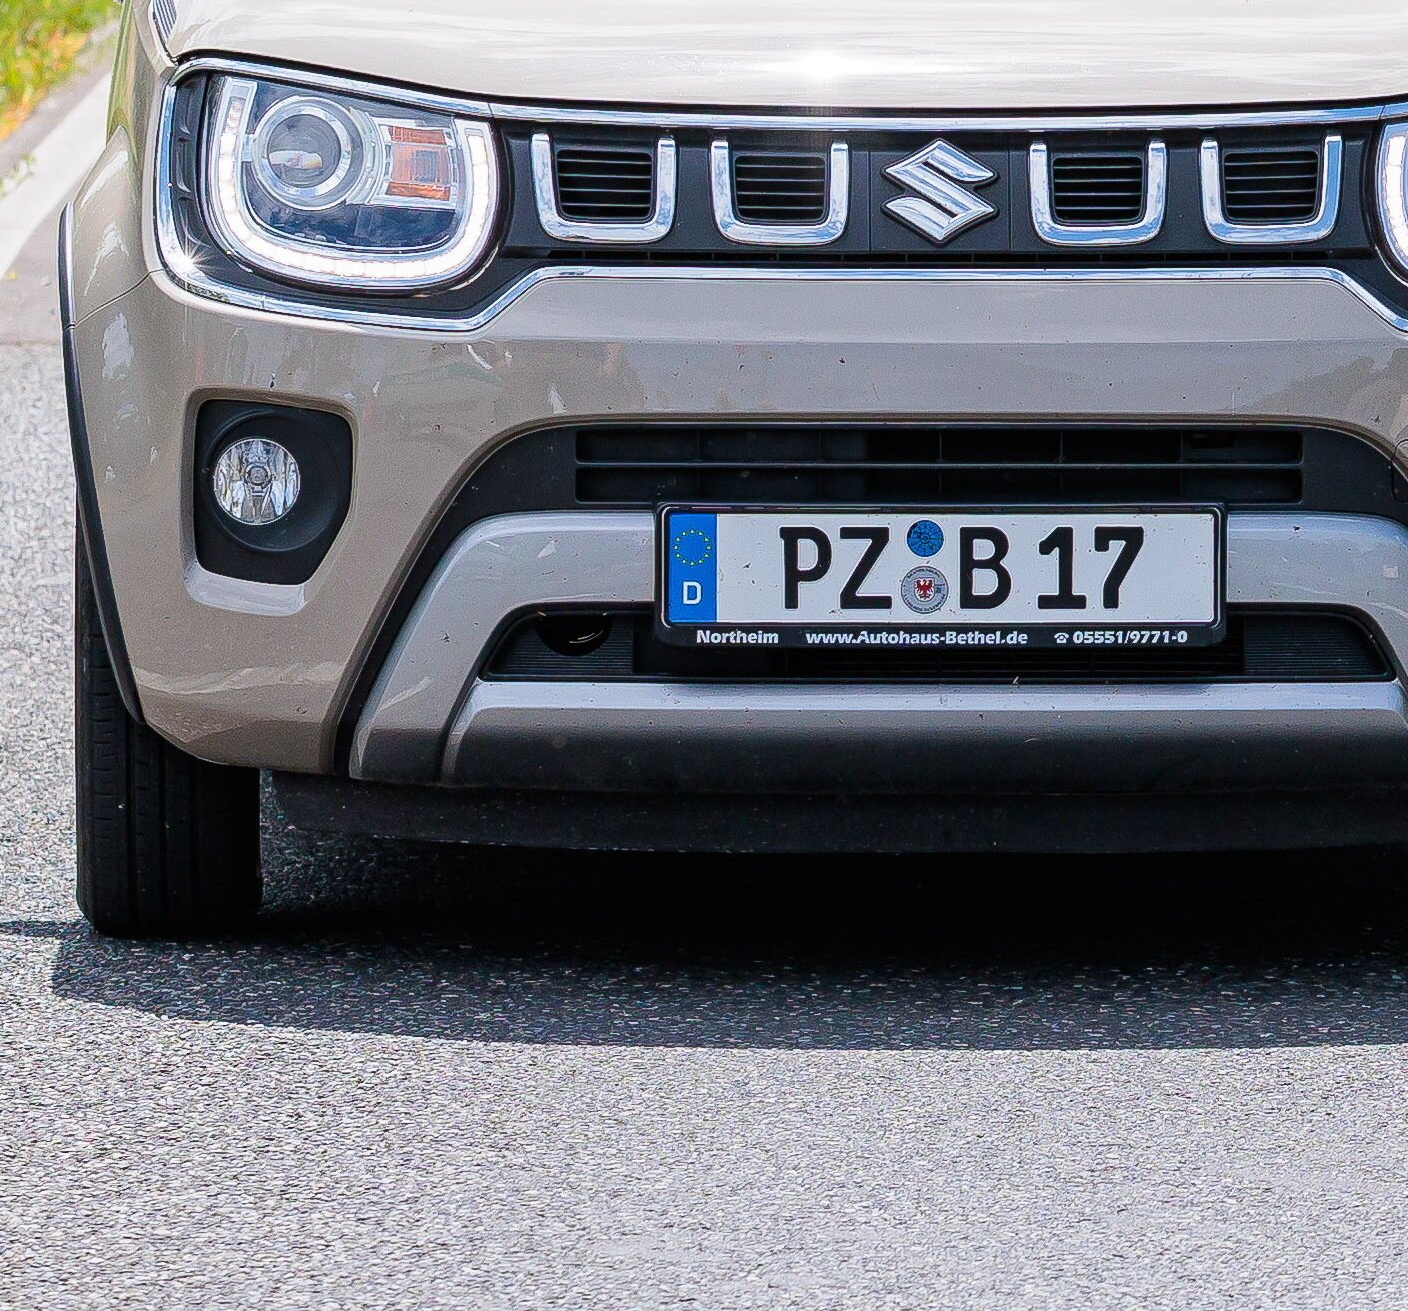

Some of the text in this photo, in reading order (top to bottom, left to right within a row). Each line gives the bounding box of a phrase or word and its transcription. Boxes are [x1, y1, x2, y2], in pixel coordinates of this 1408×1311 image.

[779, 526, 892, 609] PZ
[959, 526, 1012, 609] B
[1037, 526, 1144, 609] 17
[682, 581, 702, 605] D
[696, 630, 1189, 645] Northeim www.Autohaus-Bethel.de 05551/9771-0
